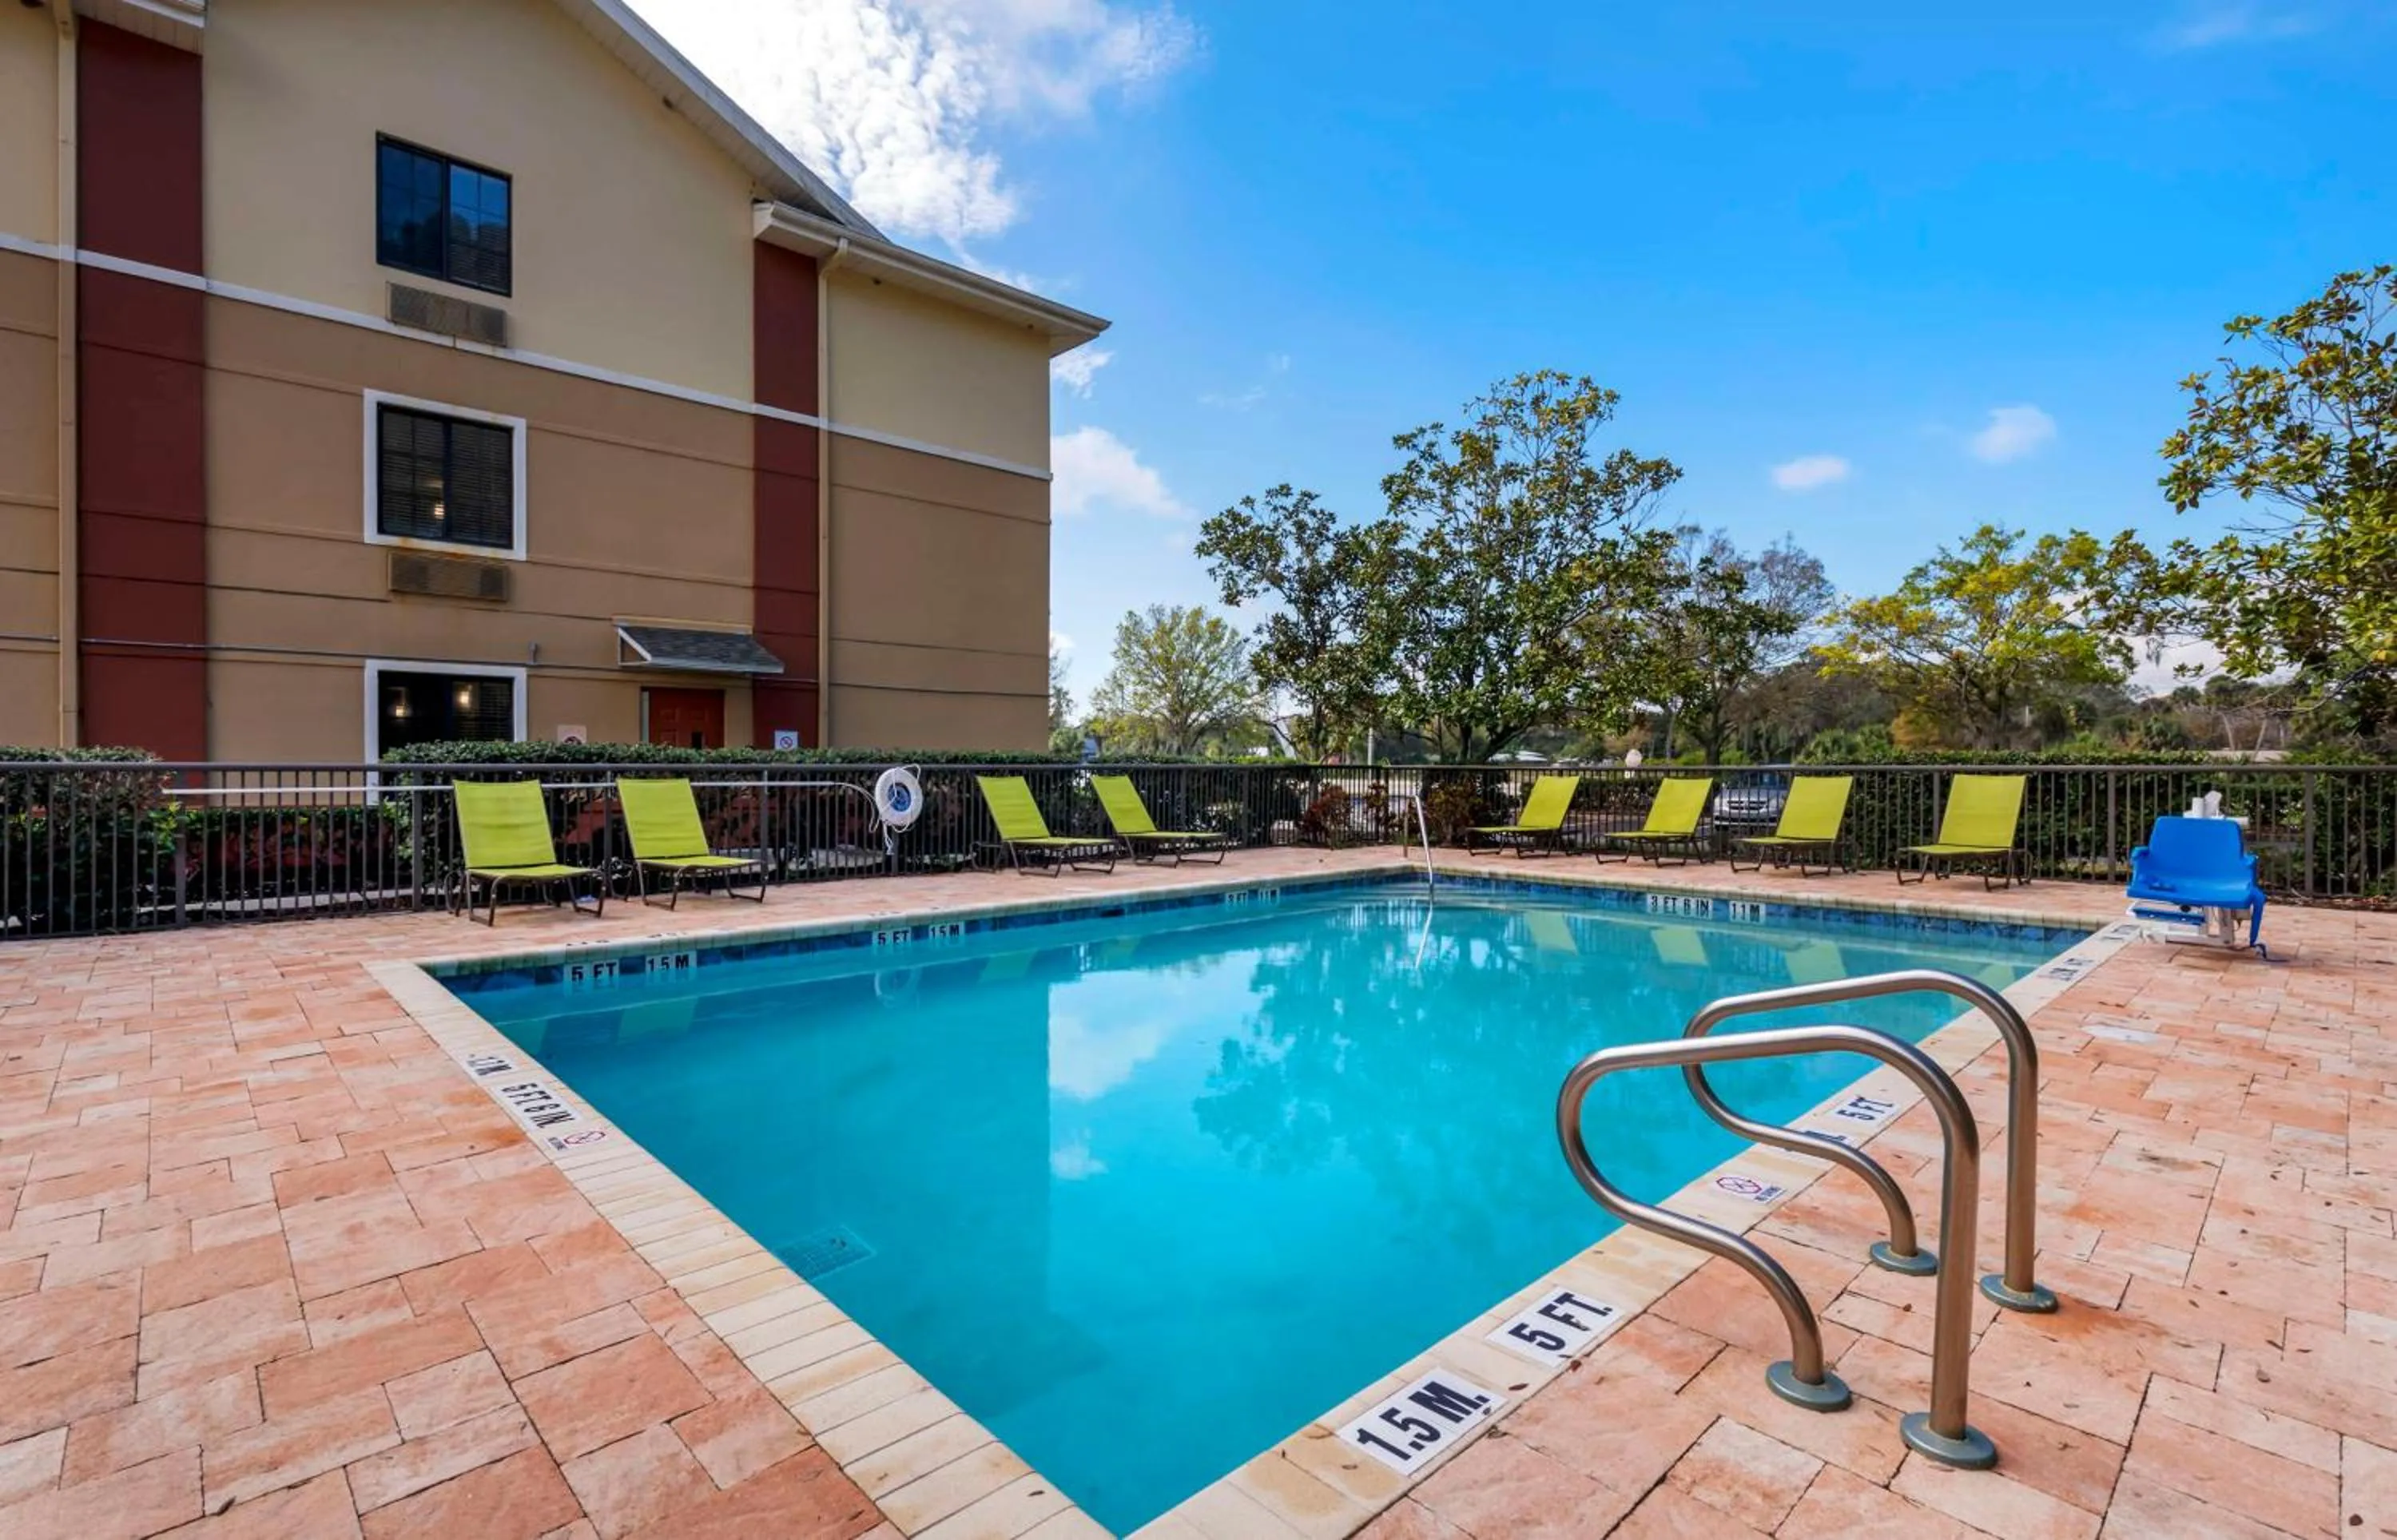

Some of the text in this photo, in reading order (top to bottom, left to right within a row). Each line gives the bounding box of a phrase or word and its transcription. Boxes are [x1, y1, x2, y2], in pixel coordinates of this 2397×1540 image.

[1664, 896, 1677, 911] FT
[1695, 899, 1710, 913] IN
[893, 929, 909, 943] FT
[675, 954, 690, 970] M
[594, 962, 617, 979] FT
[501, 1082, 538, 1092] 5
[1836, 1109, 1875, 1120] 5
[1508, 1292, 1614, 1351] 5 FT.
[1356, 1380, 1491, 1461] 1.5 M.
